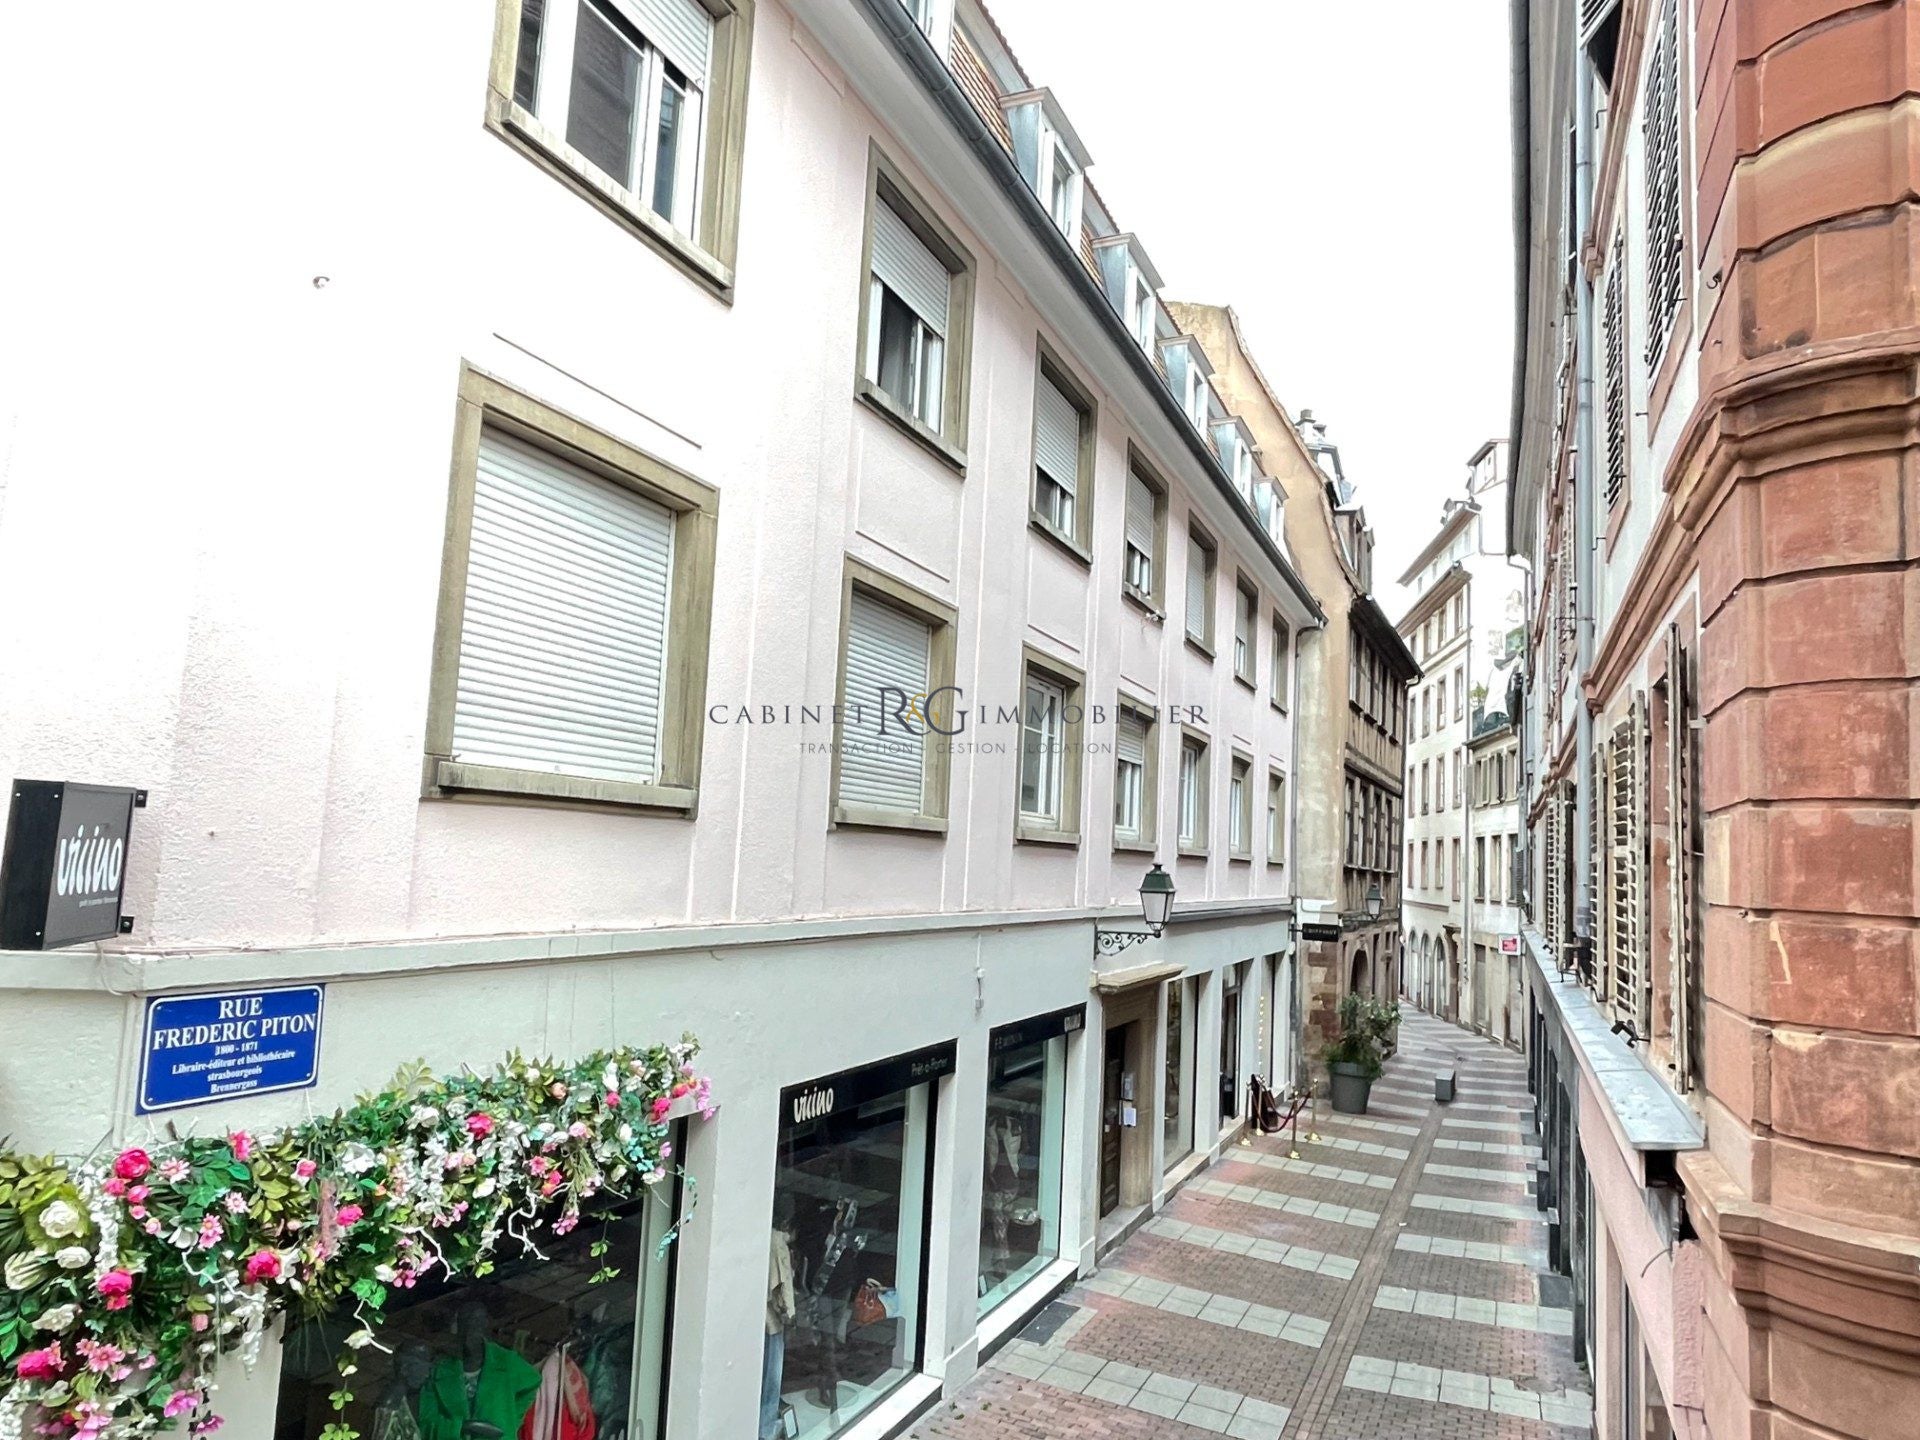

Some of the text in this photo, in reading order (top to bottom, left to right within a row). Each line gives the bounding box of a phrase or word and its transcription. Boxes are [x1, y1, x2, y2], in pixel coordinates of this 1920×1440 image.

[218, 996, 264, 1020] RUE
[153, 1012, 316, 1050] FREDERIC PITON
[241, 1041, 258, 1052] 1871
[172, 1049, 296, 1075] Libraire-éditeur et bibliothécaire
[207, 1065, 263, 1082] strasbourgeois
